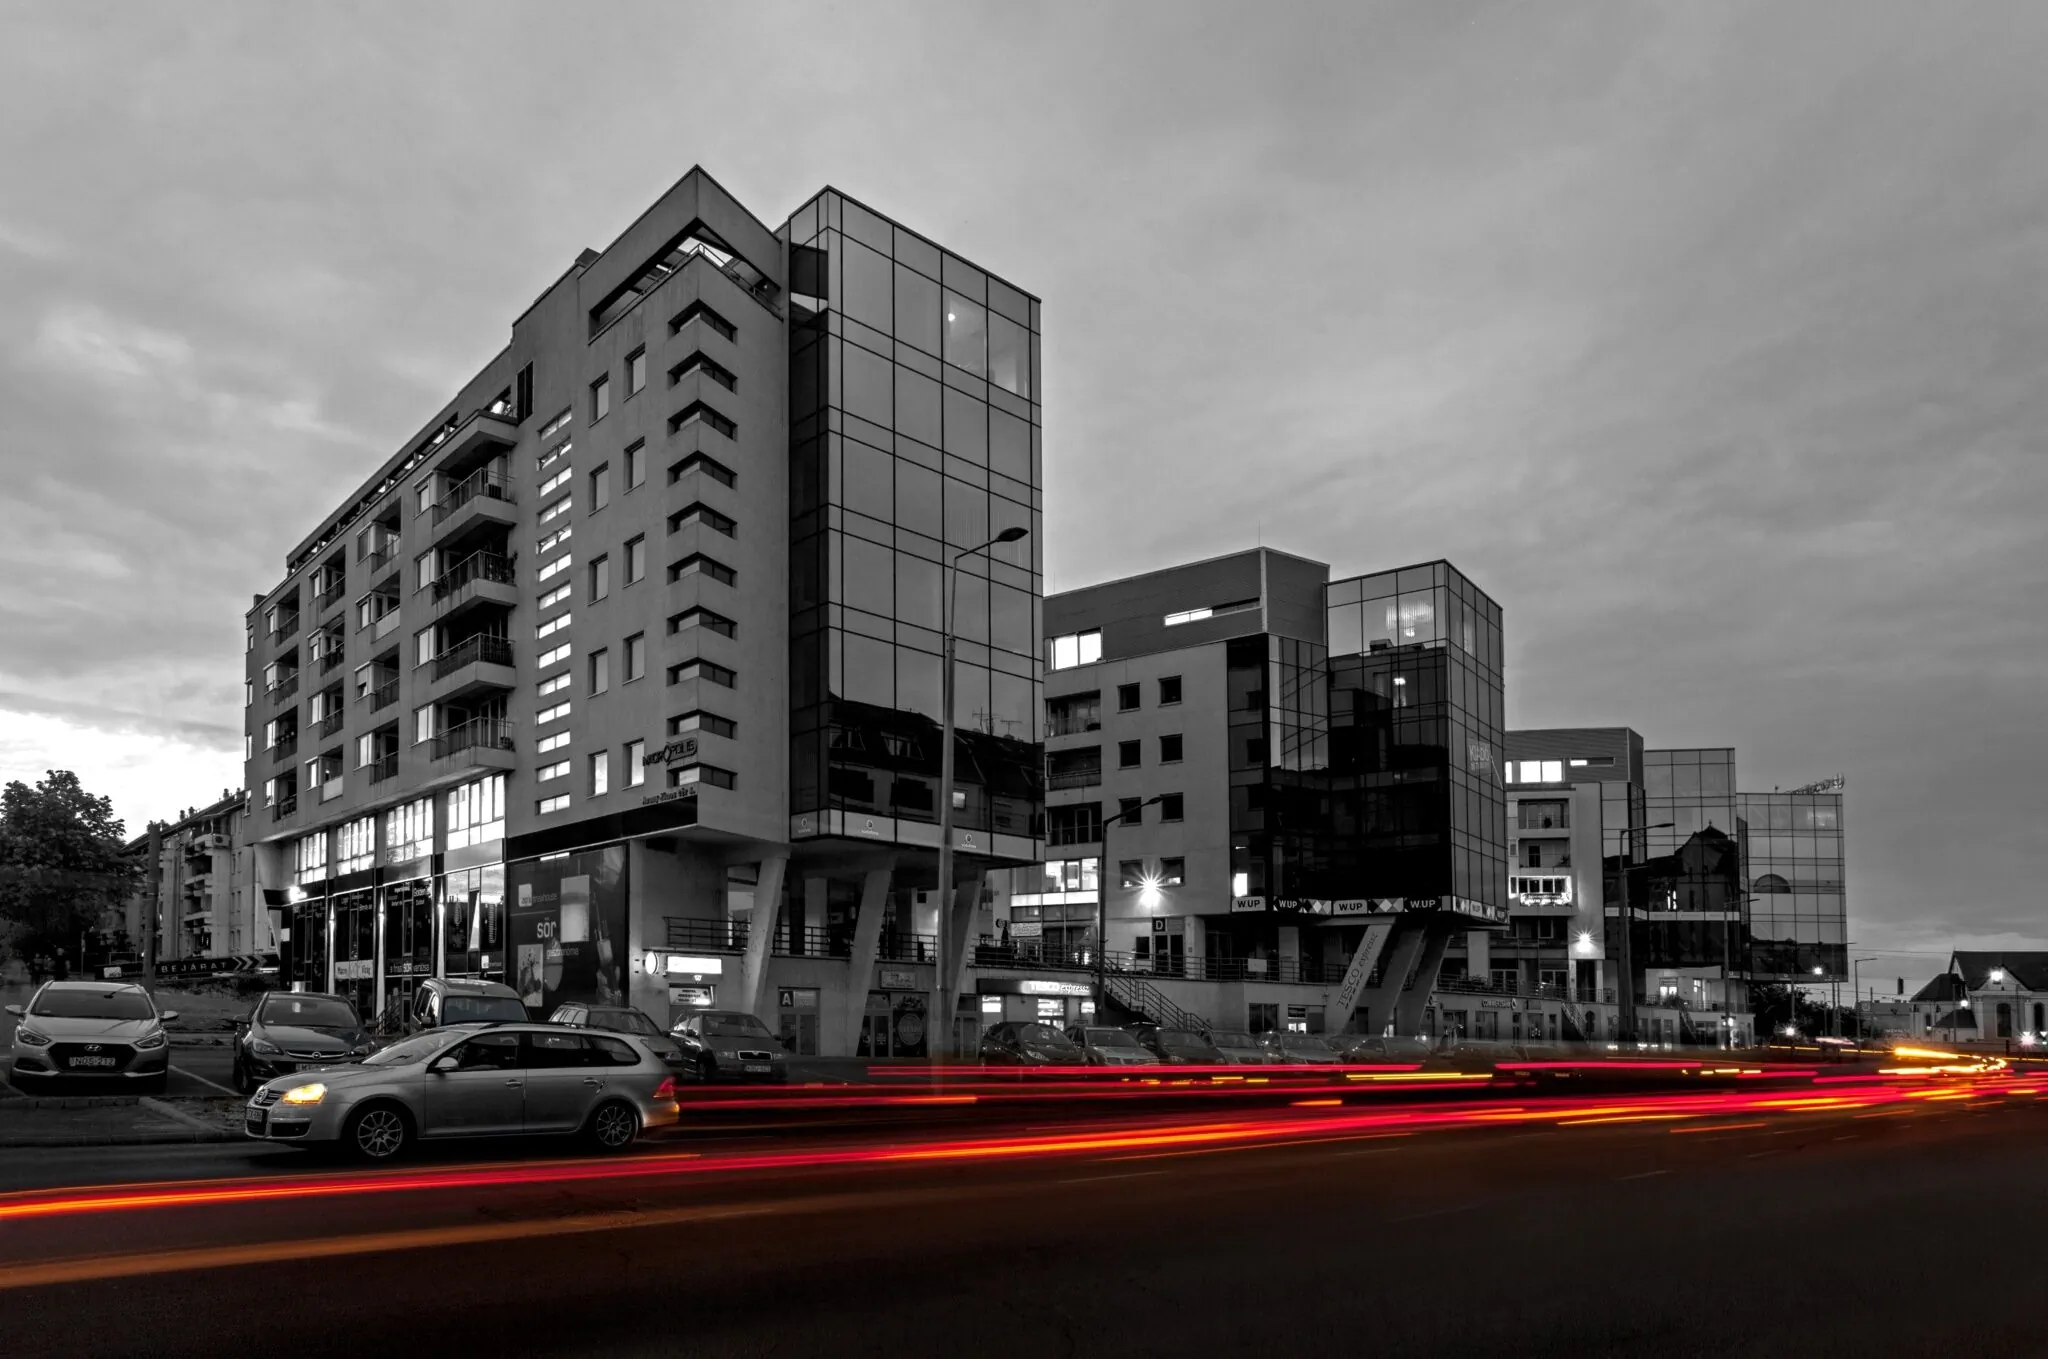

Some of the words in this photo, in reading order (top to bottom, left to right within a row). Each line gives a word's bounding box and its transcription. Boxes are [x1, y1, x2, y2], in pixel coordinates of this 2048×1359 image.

[537, 917, 557, 939] sör
[1155, 920, 1164, 930] D
[161, 961, 228, 974] BEJÁRAT
[1336, 968, 1360, 1006] TESCO
[782, 992, 792, 1005] A
